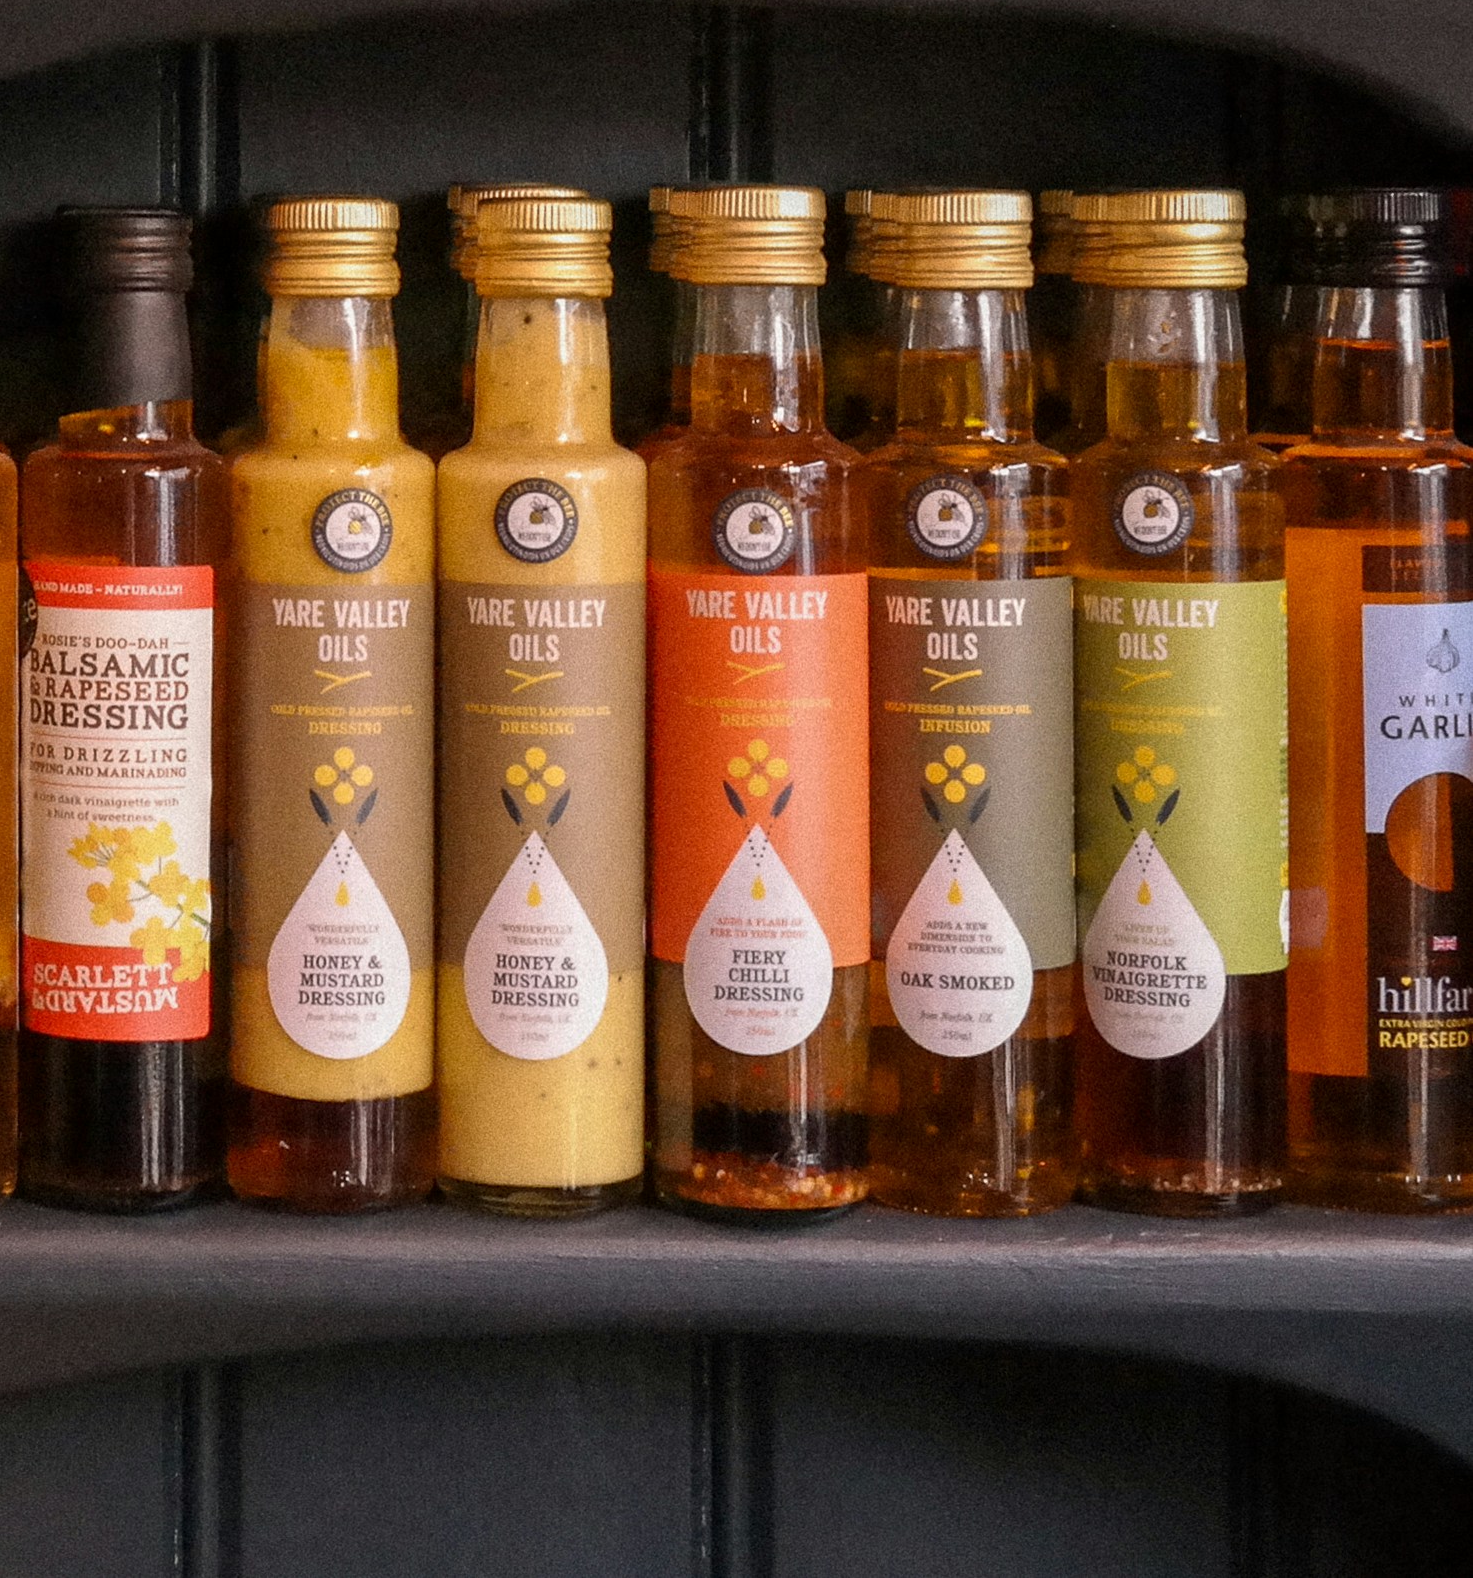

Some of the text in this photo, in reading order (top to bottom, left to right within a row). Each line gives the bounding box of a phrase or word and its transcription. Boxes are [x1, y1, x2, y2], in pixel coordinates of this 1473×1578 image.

[273, 599, 411, 629] YARE VALLEY
[467, 596, 607, 629] YARE VALLEY
[686, 589, 829, 621] YARE VALLEY
[885, 595, 1026, 628] YARE VALLEY
[1083, 593, 1219, 629] YARE VALLEY
[96, 636, 169, 650] DOO-DAH
[318, 633, 369, 663] OILS
[509, 633, 561, 663] OILS
[730, 625, 782, 655] OILS
[926, 631, 979, 662] OILS
[1118, 631, 1168, 661] OILS
[30, 651, 189, 679] BALSAMIC
[30, 679, 189, 702] & RAPESEED
[30, 702, 189, 731] DRESSING
[919, 718, 992, 734] INFUSION
[1380, 713, 1473, 739] GARLI
[302, 953, 383, 971] HONEY &
[732, 949, 787, 966] FIERY
[1106, 950, 1188, 970] NORFOLK
[299, 971, 385, 989] MUSTARD
[727, 967, 791, 985] CHILLI
[900, 972, 1015, 990] OAK SMOKED
[1092, 967, 1208, 990] VINAIGRETTE
[298, 990, 386, 1007] DRESSING
[713, 985, 805, 1002] DRESSING
[1103, 987, 1191, 1008] DRESSING
[1376, 976, 1473, 1013] hillfar
[1379, 1031, 1469, 1048] RAPESEED
